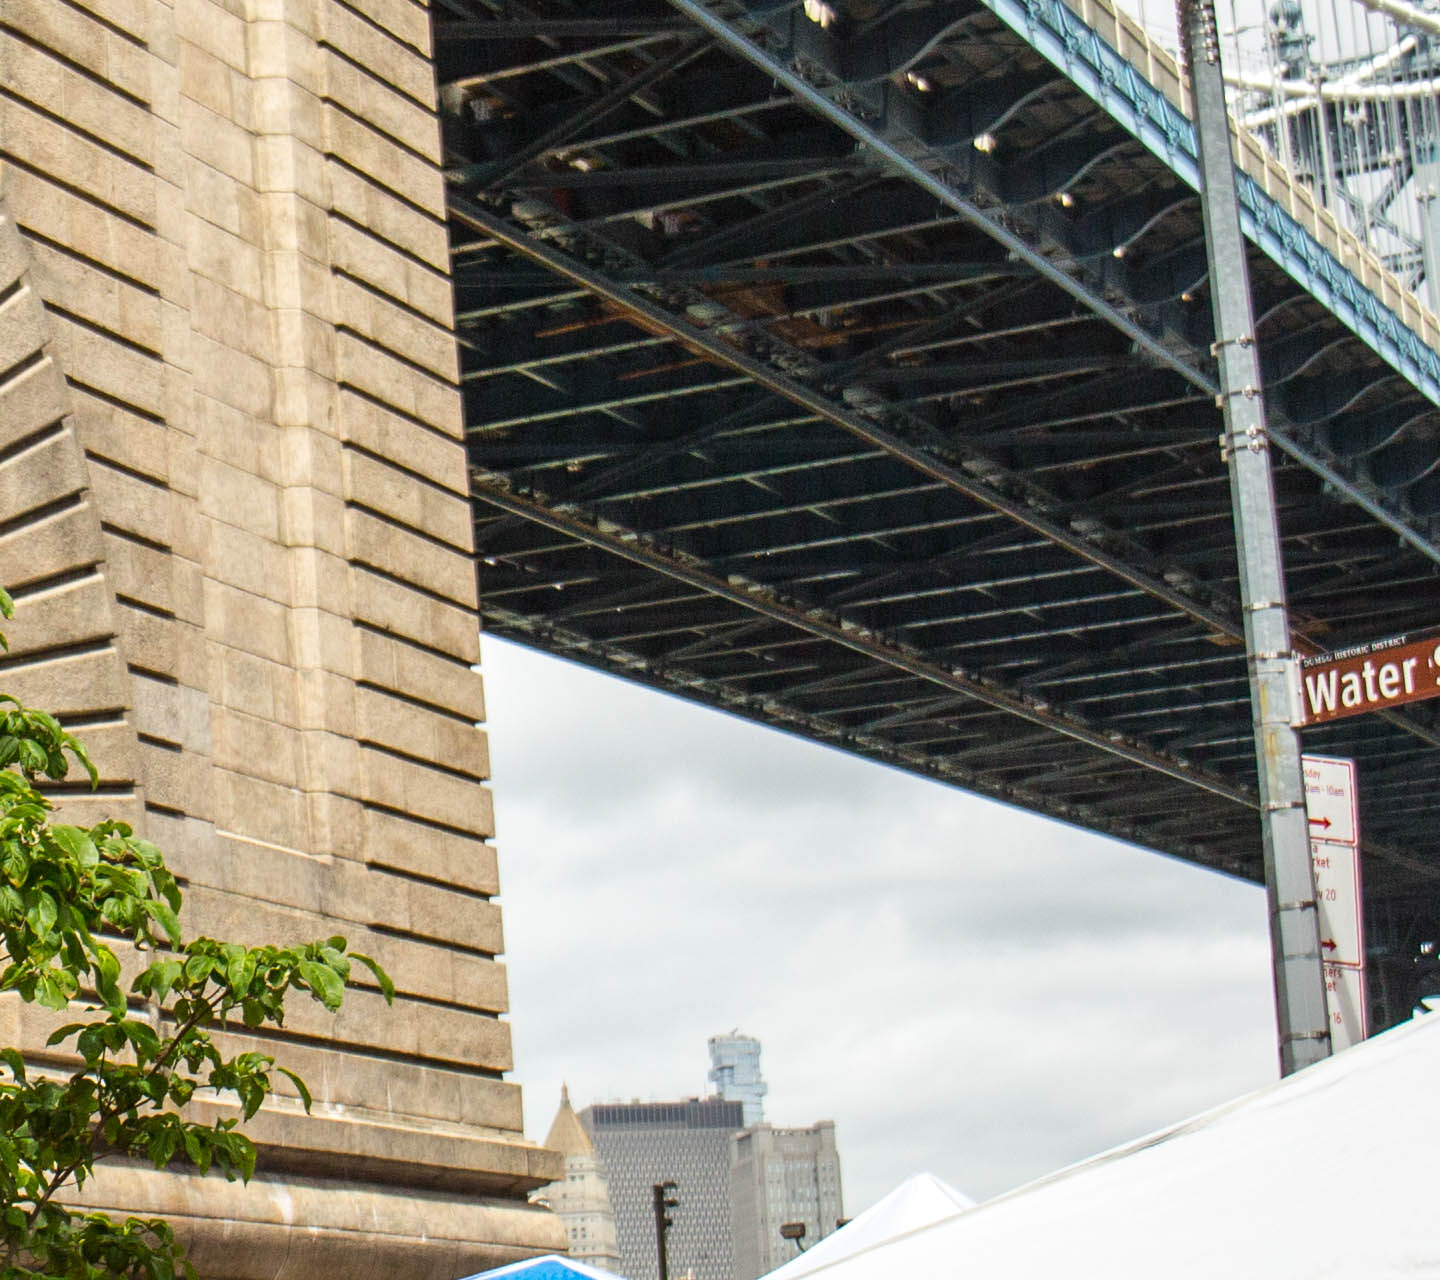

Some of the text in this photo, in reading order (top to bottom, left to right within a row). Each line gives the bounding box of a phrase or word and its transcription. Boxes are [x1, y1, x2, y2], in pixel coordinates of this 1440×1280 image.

[1334, 645, 1370, 661] HISTORIC
[1371, 635, 1407, 651] DISTRICT
[1305, 657, 1419, 715] Water
[1325, 888, 1337, 901] 20
